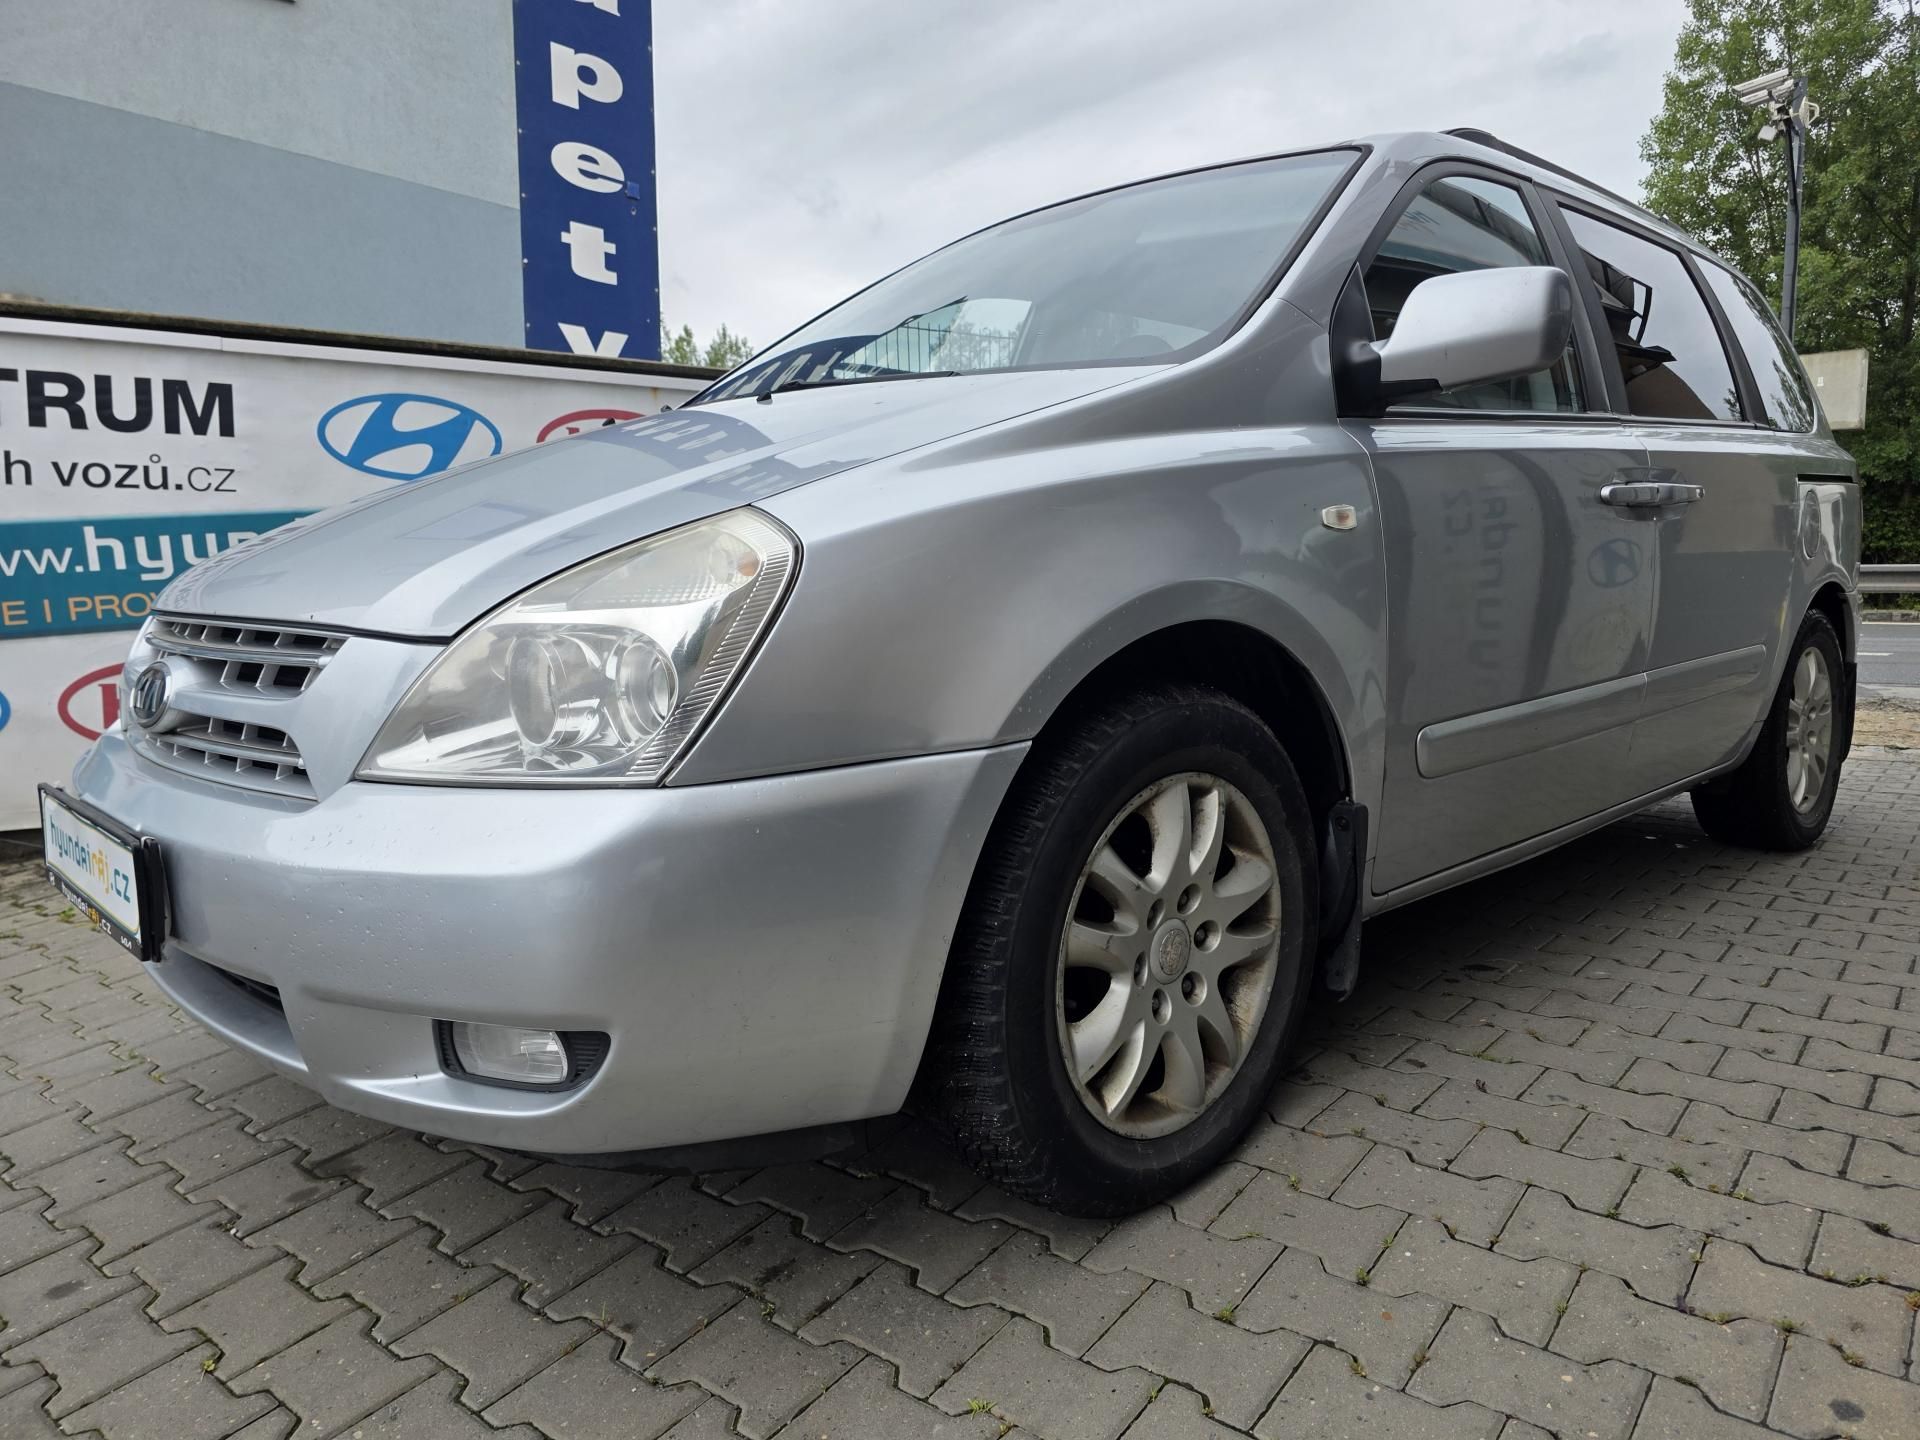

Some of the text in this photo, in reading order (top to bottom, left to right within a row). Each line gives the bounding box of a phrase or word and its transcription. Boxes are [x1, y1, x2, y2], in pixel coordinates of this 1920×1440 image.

[50, 453, 237, 493] vozů.cz
[43, 598, 53, 623] I
[68, 592, 157, 621] PRO
